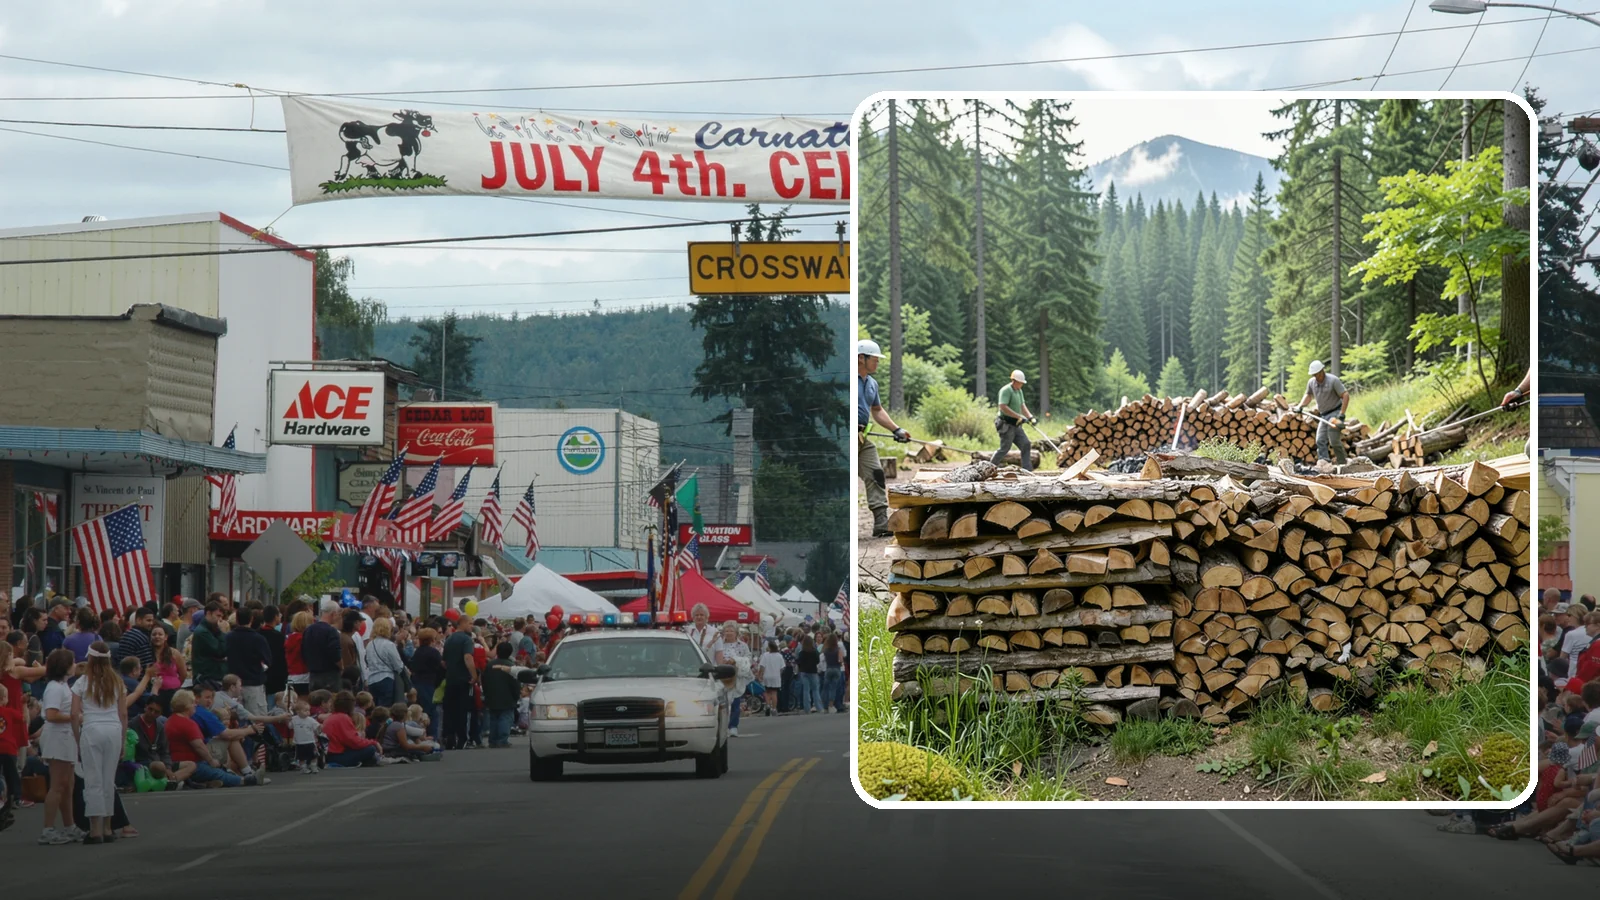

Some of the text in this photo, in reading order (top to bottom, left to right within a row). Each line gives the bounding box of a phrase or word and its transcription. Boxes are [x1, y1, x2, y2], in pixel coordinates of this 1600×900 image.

[481, 141, 604, 193] JULY
[632, 150, 746, 197] 4th.
[697, 254, 850, 280] CROSSWA
[283, 380, 374, 420] ACE
[406, 410, 452, 421] CEDAR
[283, 421, 371, 437] Hardware
[95, 485, 124, 495] Vincent
[126, 485, 136, 495] de
[138, 485, 155, 495] Paul
[688, 526, 742, 535] CRNATION
[699, 535, 730, 543] GLASS
